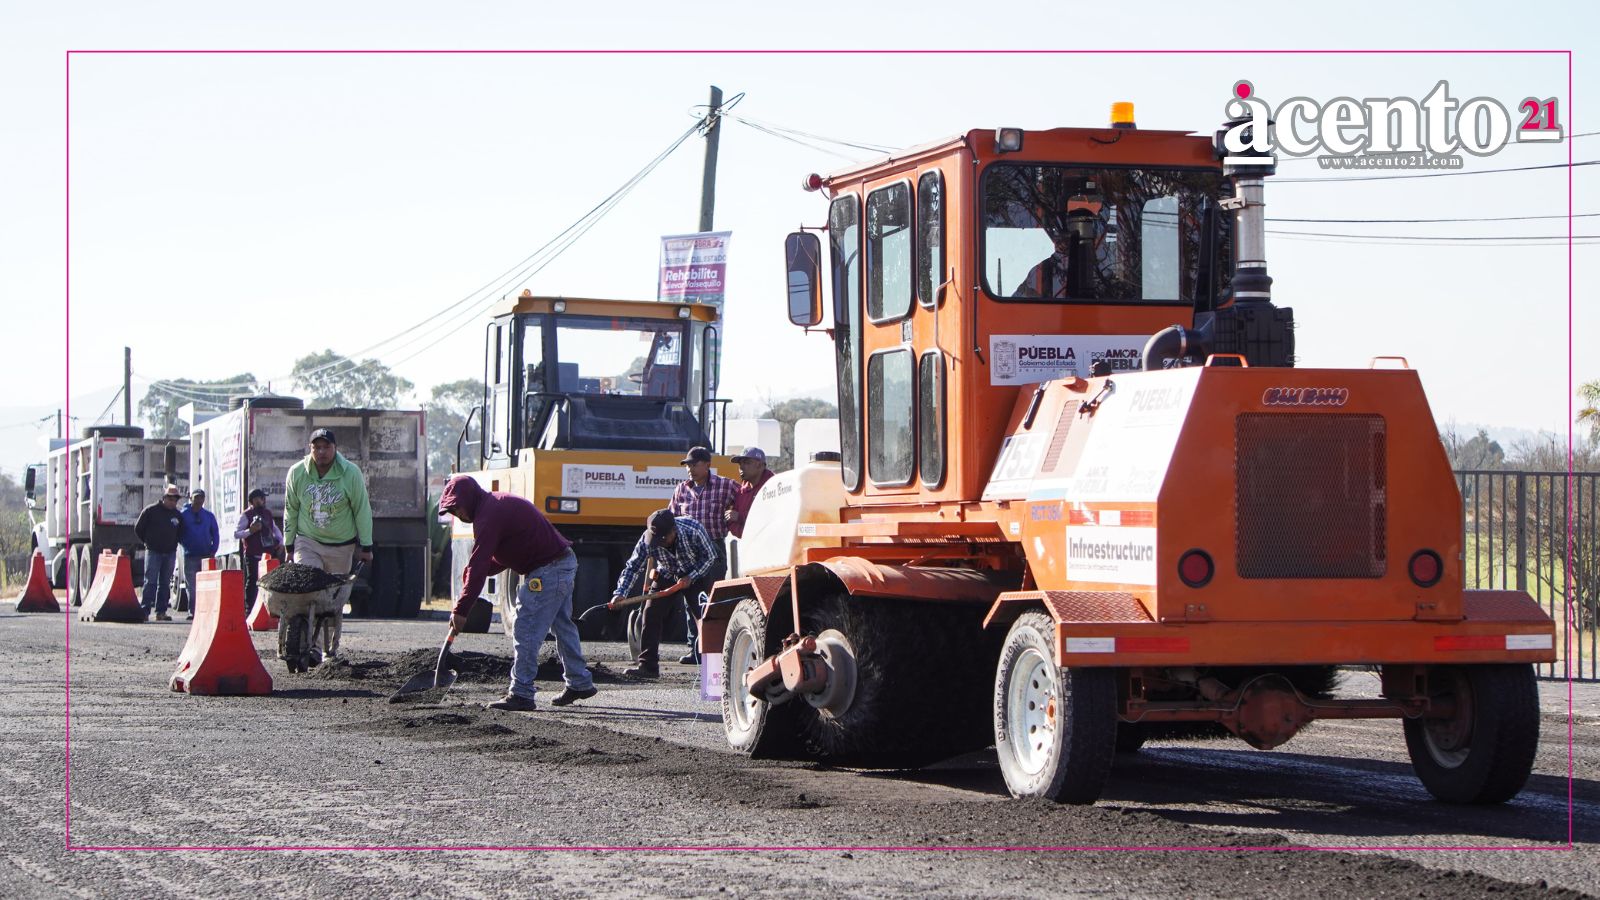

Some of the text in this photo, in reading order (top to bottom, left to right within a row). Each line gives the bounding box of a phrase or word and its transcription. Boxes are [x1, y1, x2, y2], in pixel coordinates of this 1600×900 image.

[665, 267, 718, 282] Rehabilita
[1105, 348, 1137, 359] AMOR
[584, 471, 625, 481] PUEBLA
[1069, 537, 1154, 562] Infraestructura
